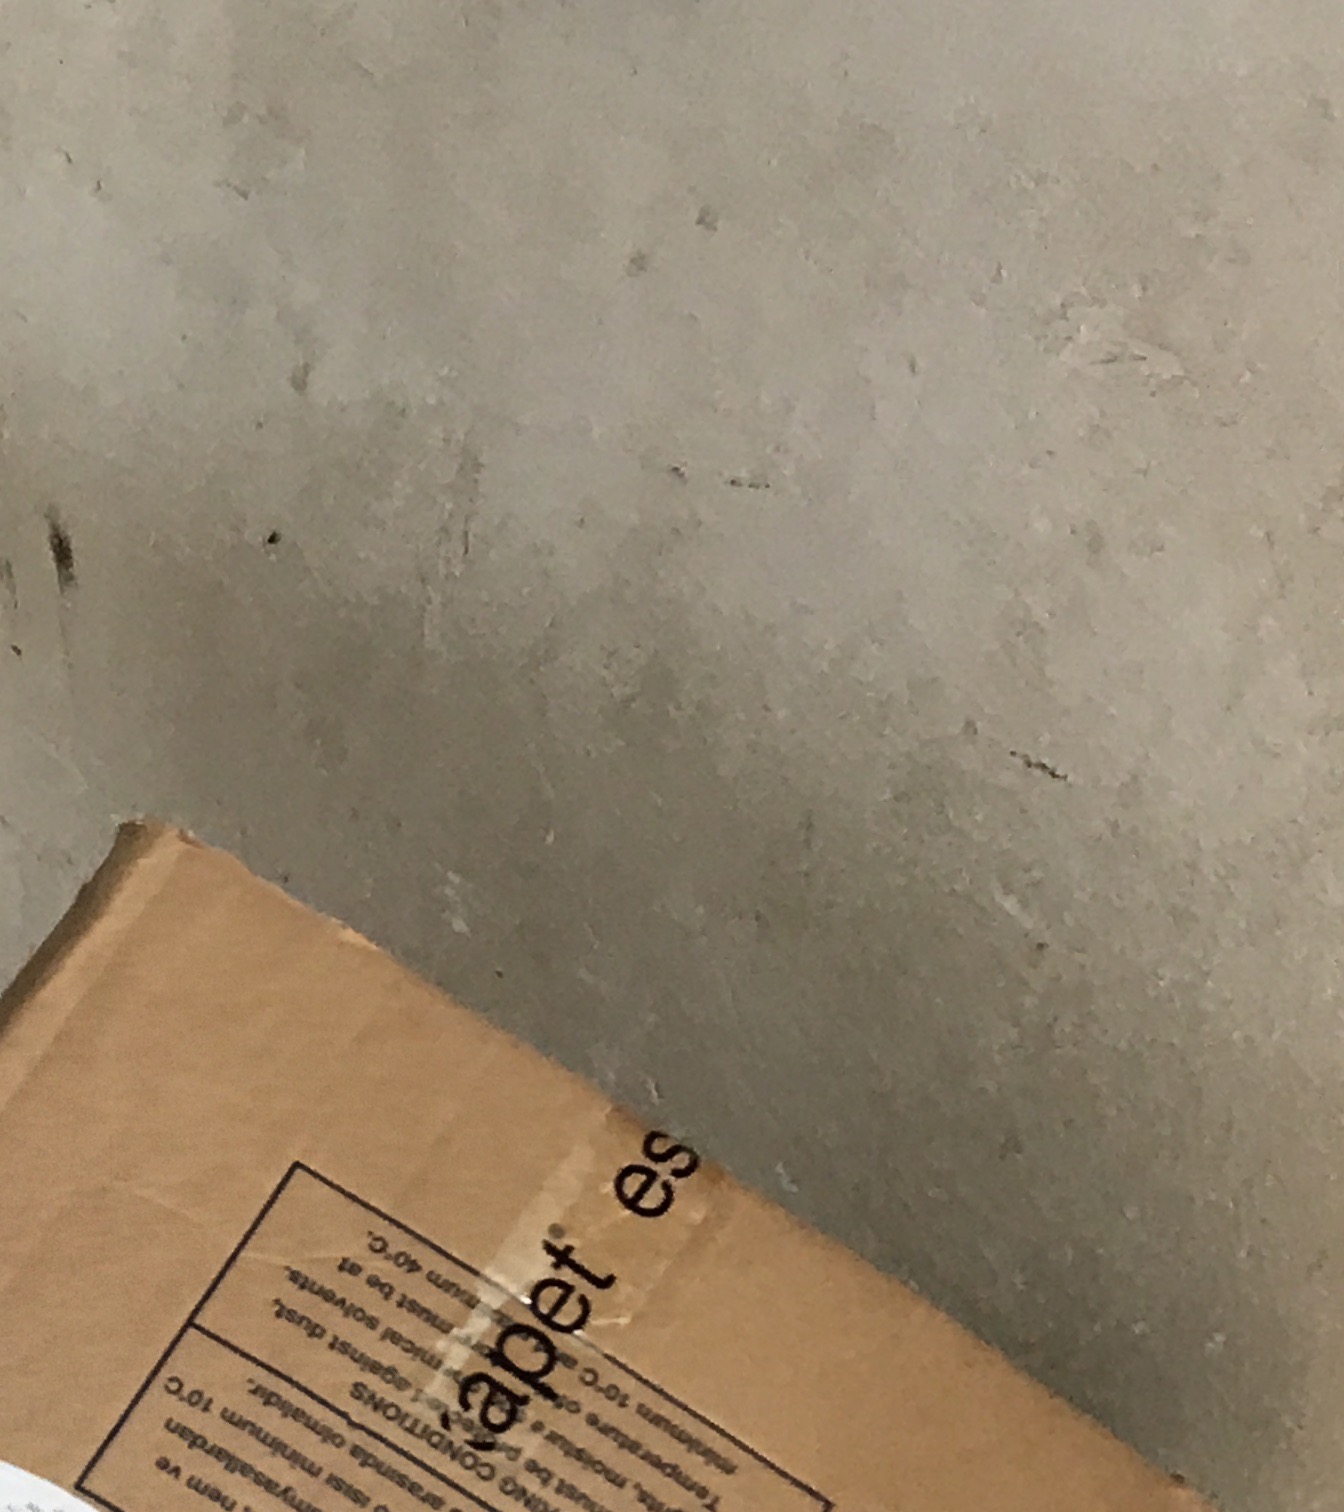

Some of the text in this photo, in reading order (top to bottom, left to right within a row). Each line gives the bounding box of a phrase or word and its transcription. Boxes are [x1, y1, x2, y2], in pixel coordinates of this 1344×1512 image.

[337, 1257, 363, 1277] at
[365, 1274, 396, 1301] be
[395, 1293, 455, 1334] must
[328, 1334, 412, 1391] against
[220, 1407, 323, 1478] minimum
[349, 1382, 496, 1481] CONDITIONS
[635, 1402, 738, 1475] minimum
[155, 1456, 181, 1480] ve
[524, 1459, 555, 1487] be
[530, 1421, 629, 1489] moisture
[185, 1475, 237, 1512] nem
